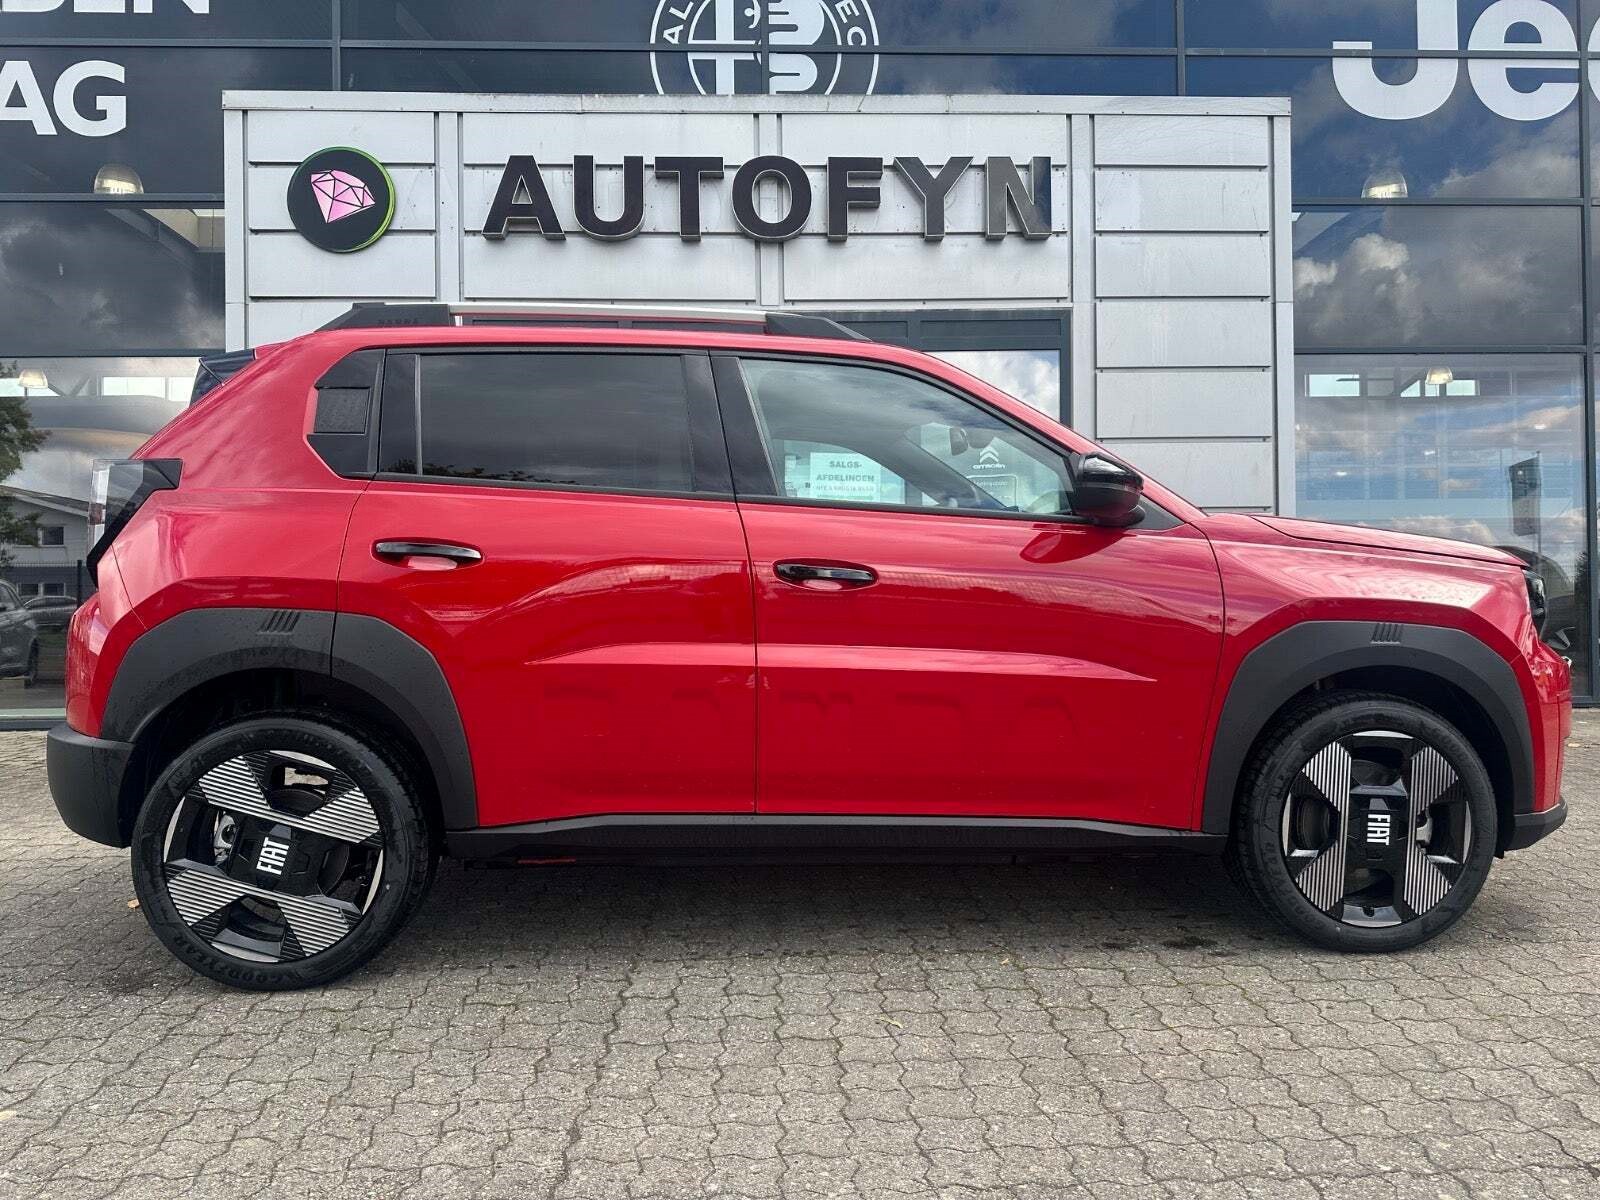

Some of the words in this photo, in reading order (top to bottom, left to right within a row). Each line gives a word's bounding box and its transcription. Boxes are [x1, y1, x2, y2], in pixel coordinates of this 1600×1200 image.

[1332, 0, 1600, 121] Je
[481, 155, 1053, 242] AUTOFYN
[828, 460, 863, 469] SALGS-
[1366, 814, 1391, 846] FIAT
[256, 836, 290, 876] FIAT
